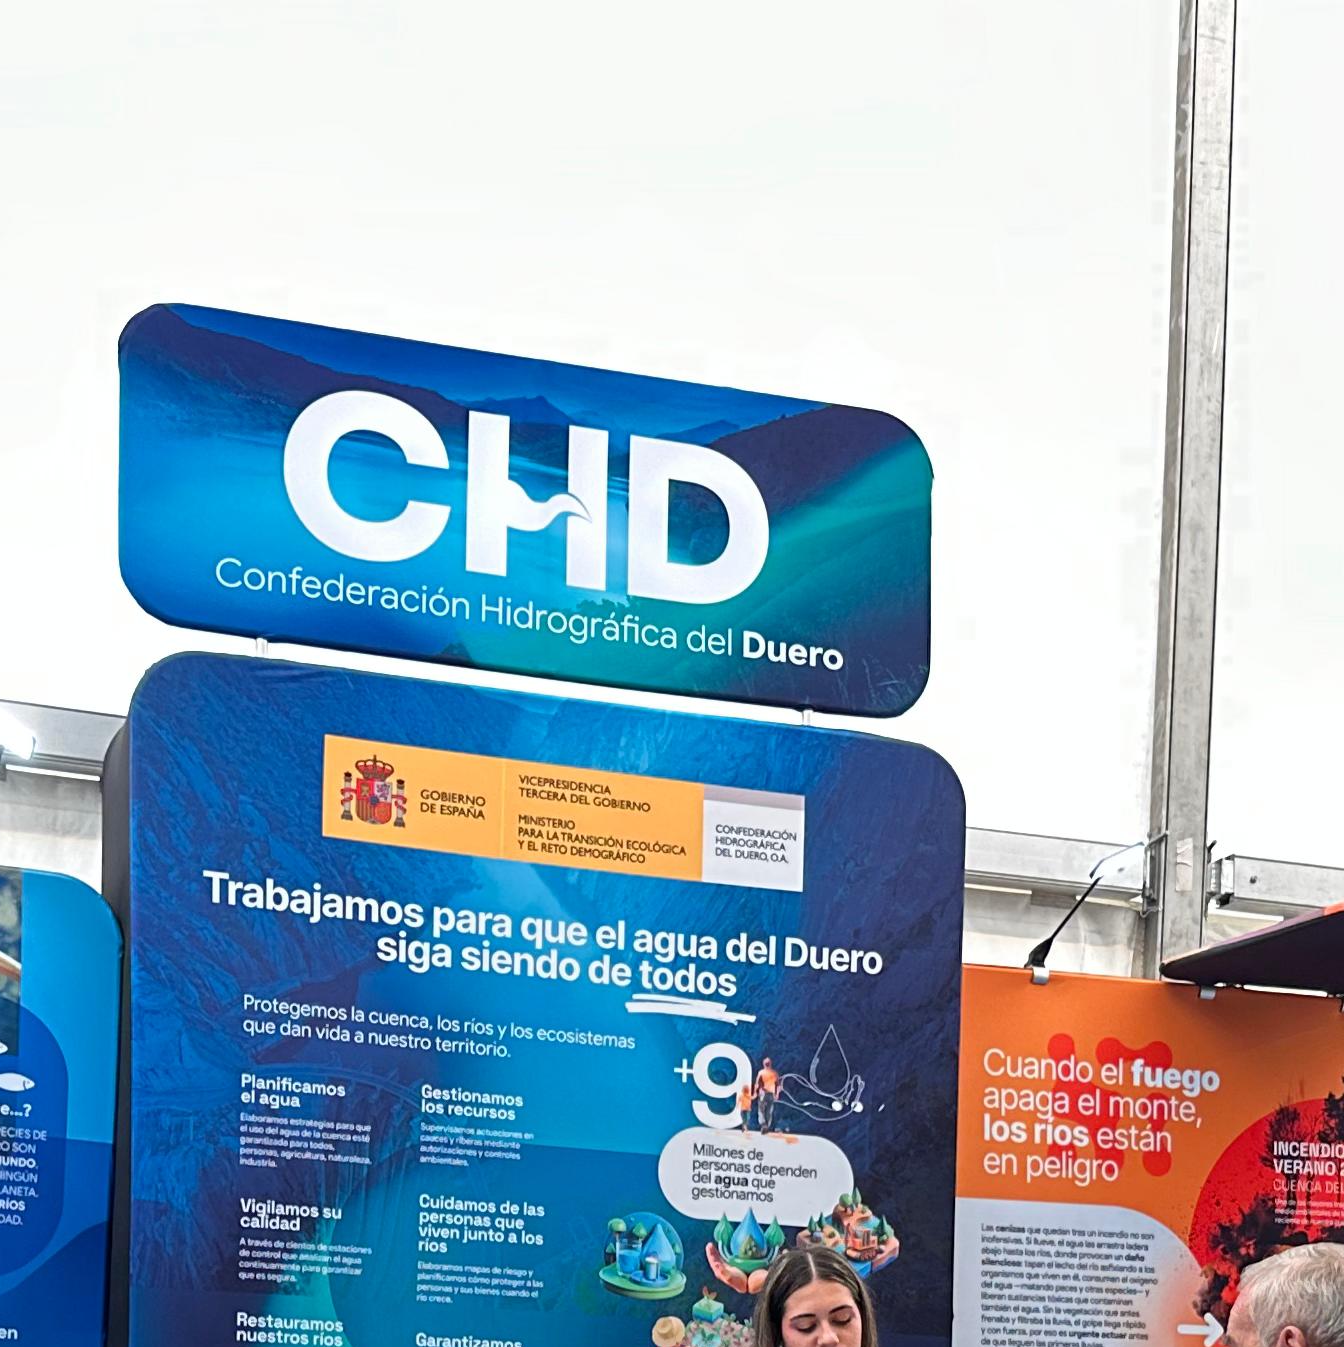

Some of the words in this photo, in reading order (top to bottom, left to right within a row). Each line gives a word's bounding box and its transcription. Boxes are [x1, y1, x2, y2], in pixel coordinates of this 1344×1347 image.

[283, 390, 770, 605] CHD
[216, 558, 471, 618] Confederación
[481, 593, 678, 648] Hidrográfica
[687, 611, 733, 657] del
[742, 631, 844, 672] Duero
[518, 775, 611, 795] VICEPRESIDENCIA
[420, 789, 486, 808] GOBIERNO
[518, 788, 567, 803] TERCERA
[570, 794, 590, 806] DEL
[593, 796, 651, 812] GOBIERNO
[420, 803, 437, 815] DE
[439, 804, 485, 820] ESPAÑA
[518, 815, 576, 830] MINISTERIO
[715, 824, 797, 841] CONFEDERACIÓN
[518, 828, 543, 840] PARA
[546, 831, 559, 842] LA
[561, 831, 624, 848] TRANSICIÓN
[626, 838, 687, 856] ECOLÓGICA
[518, 841, 525, 850] Y
[528, 842, 538, 852] EL
[541, 842, 567, 855] RETO
[570, 846, 646, 864] DEMOGRÁFICO
[715, 848, 731, 857] DEL
[735, 849, 768, 862] DUERO,
[203, 870, 425, 929] Trabajamos
[432, 903, 511, 940] para
[521, 915, 588, 951] que
[596, 918, 626, 949] el
[633, 929, 718, 963] agua
[725, 934, 777, 967] del
[784, 944, 884, 975] Duero
[377, 932, 452, 973] siga
[460, 944, 581, 983] siendo
[589, 954, 631, 986] de
[640, 960, 737, 997] todos
[244, 996, 347, 1022] Protegemos
[351, 1005, 364, 1023] la
[368, 1011, 431, 1031] cuenca,
[437, 1014, 459, 1033] los
[465, 1018, 493, 1035] ríos
[497, 1023, 507, 1040] y
[511, 1021, 533, 1038] los
[537, 1026, 636, 1049] ecosistemas
[242, 1019, 275, 1039] que
[280, 1020, 310, 1038] dan
[315, 1022, 349, 1041] vida
[354, 1032, 364, 1044] a
[368, 1031, 430, 1049] nuestro
[435, 1036, 511, 1059] territorio.
[984, 1048, 1093, 1083] Cuando
[1101, 1058, 1124, 1085] el
[1131, 1059, 1220, 1097] fuego
[241, 1074, 346, 1098] Planificamos
[421, 1084, 524, 1108] Gestionamos
[674, 1042, 752, 1130] +9
[241, 1091, 256, 1104] el
[259, 1095, 301, 1109] agua
[421, 1099, 444, 1114] los
[448, 1104, 515, 1121] recursos
[984, 1086, 1070, 1120] apaga
[1078, 1087, 1100, 1115] el
[1109, 1094, 1202, 1128] monte,
[984, 1113, 1027, 1143] los
[1034, 1117, 1089, 1147] ríos
[1096, 1124, 1171, 1152] están
[693, 1143, 744, 1160] Millones
[747, 1147, 764, 1161] de
[693, 1159, 751, 1174] personas
[753, 1163, 817, 1179] dependen
[984, 1153, 1017, 1175] en
[1026, 1152, 1119, 1186] peligro
[1273, 1158, 1336, 1176] VERANO
[692, 1172, 711, 1184] del
[714, 1176, 748, 1188] agua
[751, 1177, 775, 1189] que
[1273, 1179, 1322, 1194] CUENCA
[691, 1186, 773, 1202] gestionamos
[240, 1198, 318, 1219] Vigilamos
[323, 1206, 342, 1220] su
[419, 1194, 497, 1215] Cuidamos
[500, 1201, 520, 1216] de
[524, 1201, 545, 1217] las
[240, 1215, 301, 1231] calidad
[419, 1212, 490, 1228] personas
[495, 1216, 524, 1231] que
[418, 1239, 448, 1253] ríos
[419, 1226, 459, 1241] viven
[463, 1226, 504, 1243] junto
[508, 1231, 517, 1242] a
[521, 1230, 544, 1246] los
[237, 1312, 344, 1332] Restauramos
[236, 1330, 309, 1346] nuestros
[313, 1332, 343, 1347] ríos
